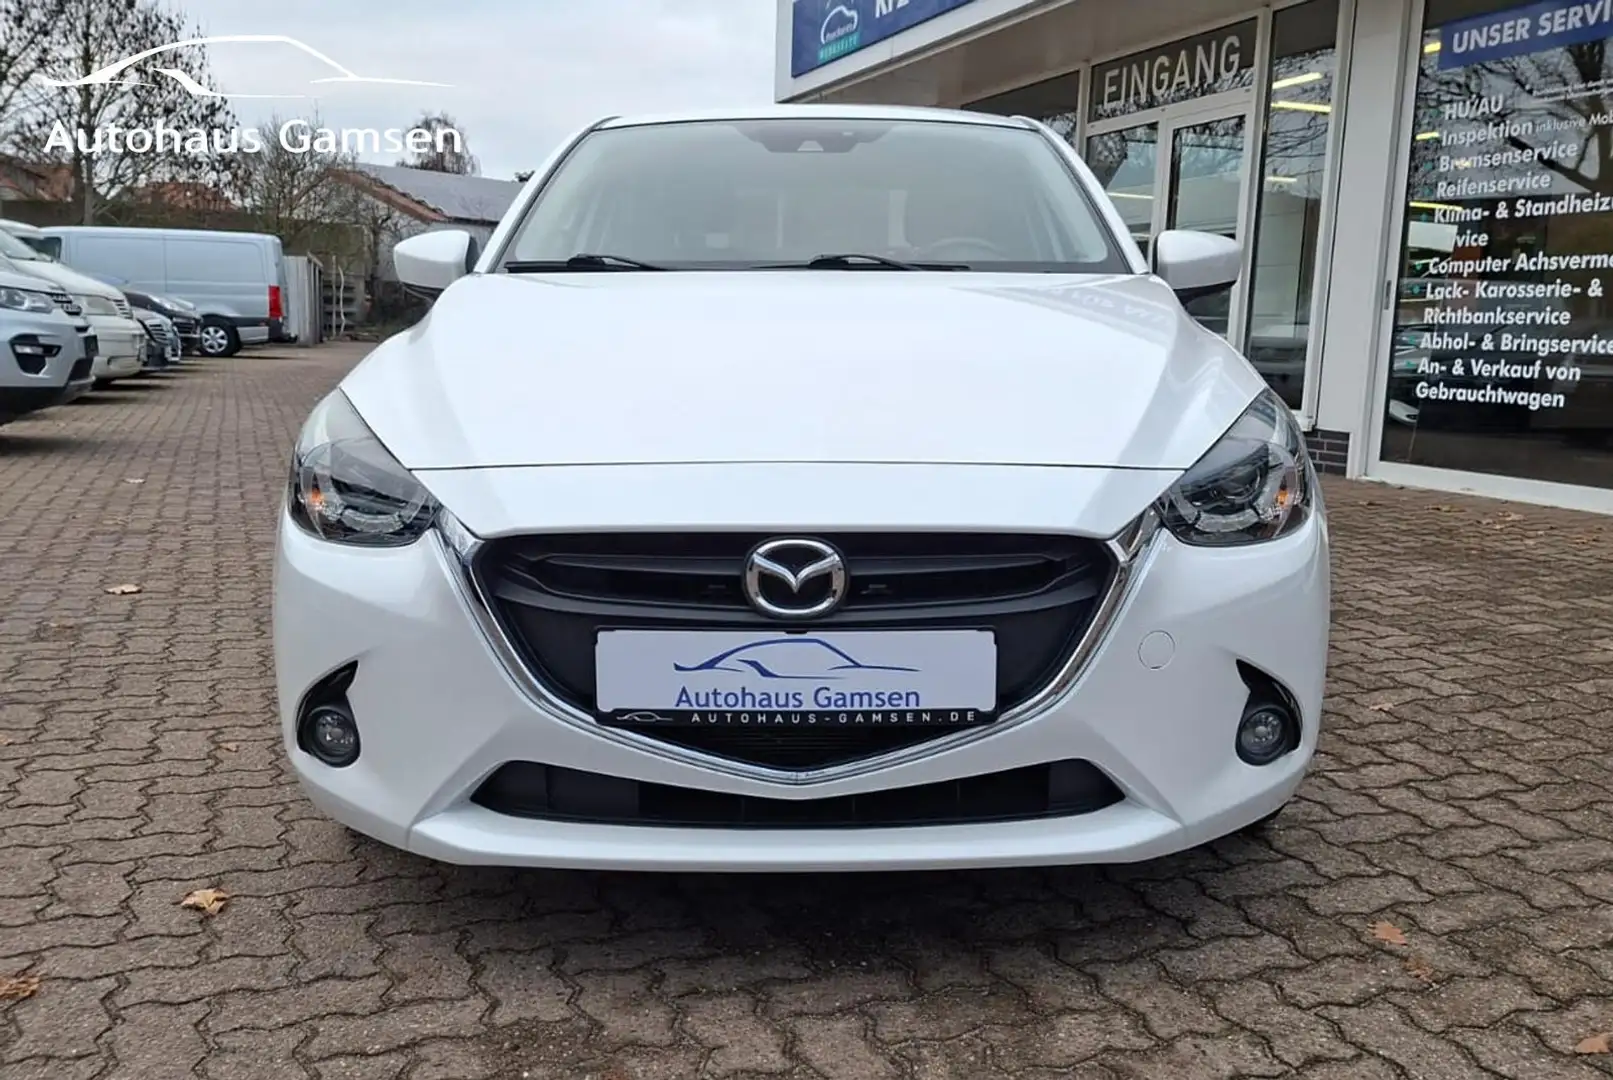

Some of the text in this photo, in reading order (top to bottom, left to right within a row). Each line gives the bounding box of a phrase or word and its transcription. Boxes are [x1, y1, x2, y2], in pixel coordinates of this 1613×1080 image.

[1452, 0, 1613, 54] UNSER SERVI
[1103, 35, 1241, 110] EINGANG
[1444, 95, 1504, 120] HU/AU
[1441, 120, 1533, 148] Inspektion
[1436, 171, 1551, 199] Reifenservice
[1495, 200, 1510, 219] &
[1514, 192, 1613, 218] Standheiz
[1453, 229, 1489, 248] vice
[1428, 256, 1511, 277] Computer
[1425, 278, 1603, 300] Lack- Karosserie- &
[1423, 306, 1572, 325] Richtbankservice
[1419, 331, 1613, 357] Abhol- & Bringservice
[1417, 357, 1581, 381] An- & Verkauf von
[1415, 382, 1565, 410] Gebrauchtwagen
[675, 686, 920, 708] Autohaus Gamsen
[691, 710, 975, 724] AUTOHAUS-GAMSEN.DE
